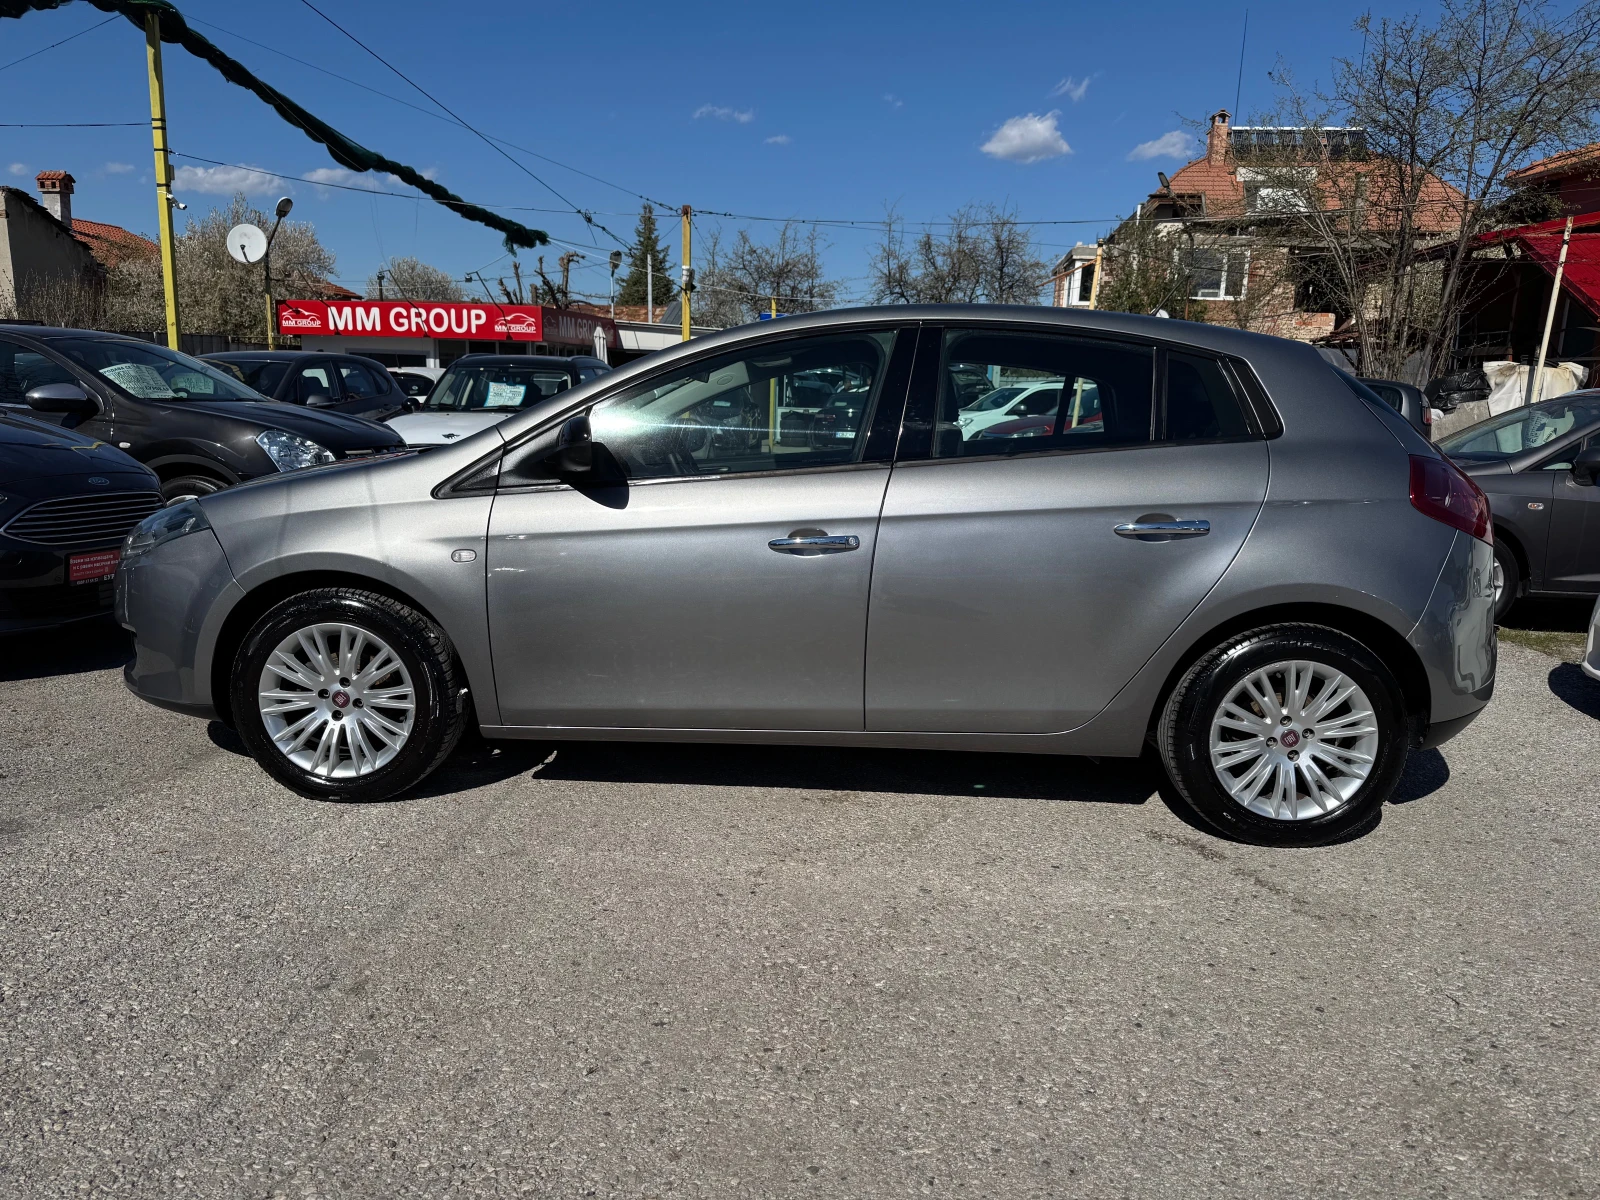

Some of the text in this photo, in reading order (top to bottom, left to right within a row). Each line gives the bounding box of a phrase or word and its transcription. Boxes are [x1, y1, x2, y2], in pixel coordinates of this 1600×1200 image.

[328, 306, 487, 334] MM GROUP
[558, 315, 576, 338] MM
[1284, 732, 1296, 745] FIAT
